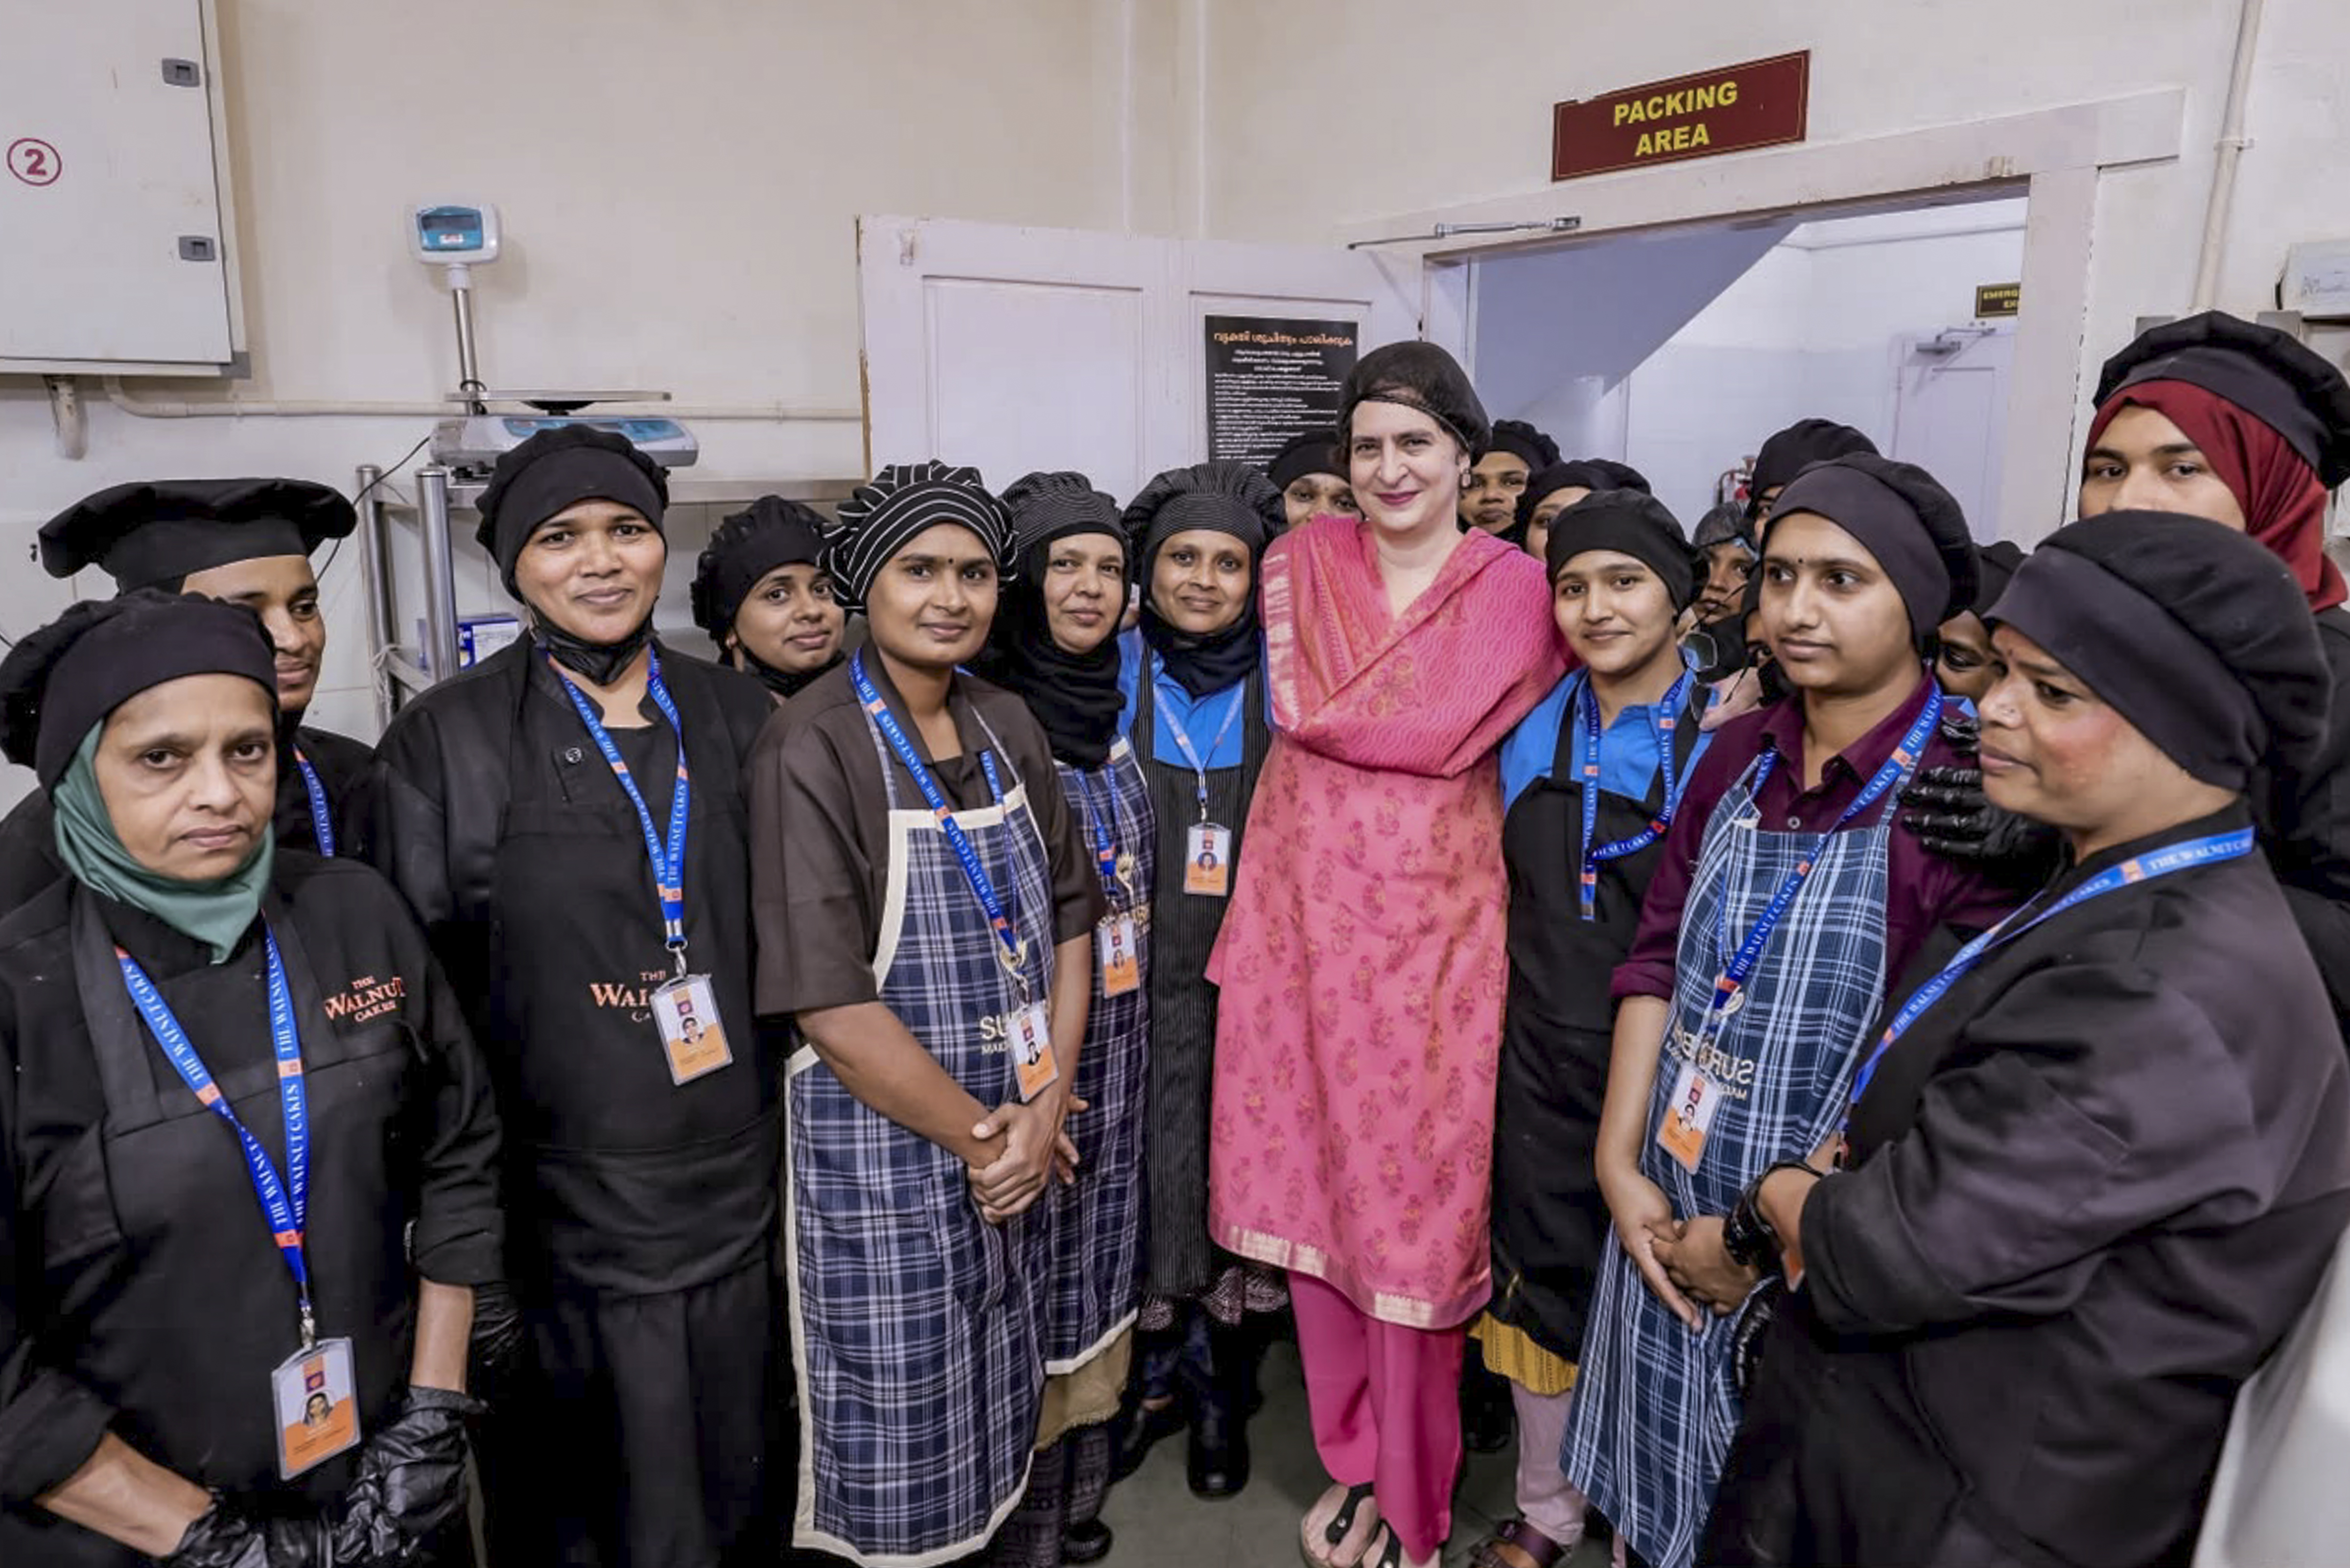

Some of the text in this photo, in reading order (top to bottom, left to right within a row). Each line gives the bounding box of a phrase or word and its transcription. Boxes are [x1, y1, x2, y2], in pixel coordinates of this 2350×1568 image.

[1614, 81, 1738, 127] PACKING
[1635, 123, 1711, 157] AREA
[24, 148, 47, 176] 2
[1983, 290, 2018, 299] EMERG
[351, 976, 376, 988] THE
[325, 977, 406, 1020] WALNUT
[354, 1000, 397, 1022] CAKES
